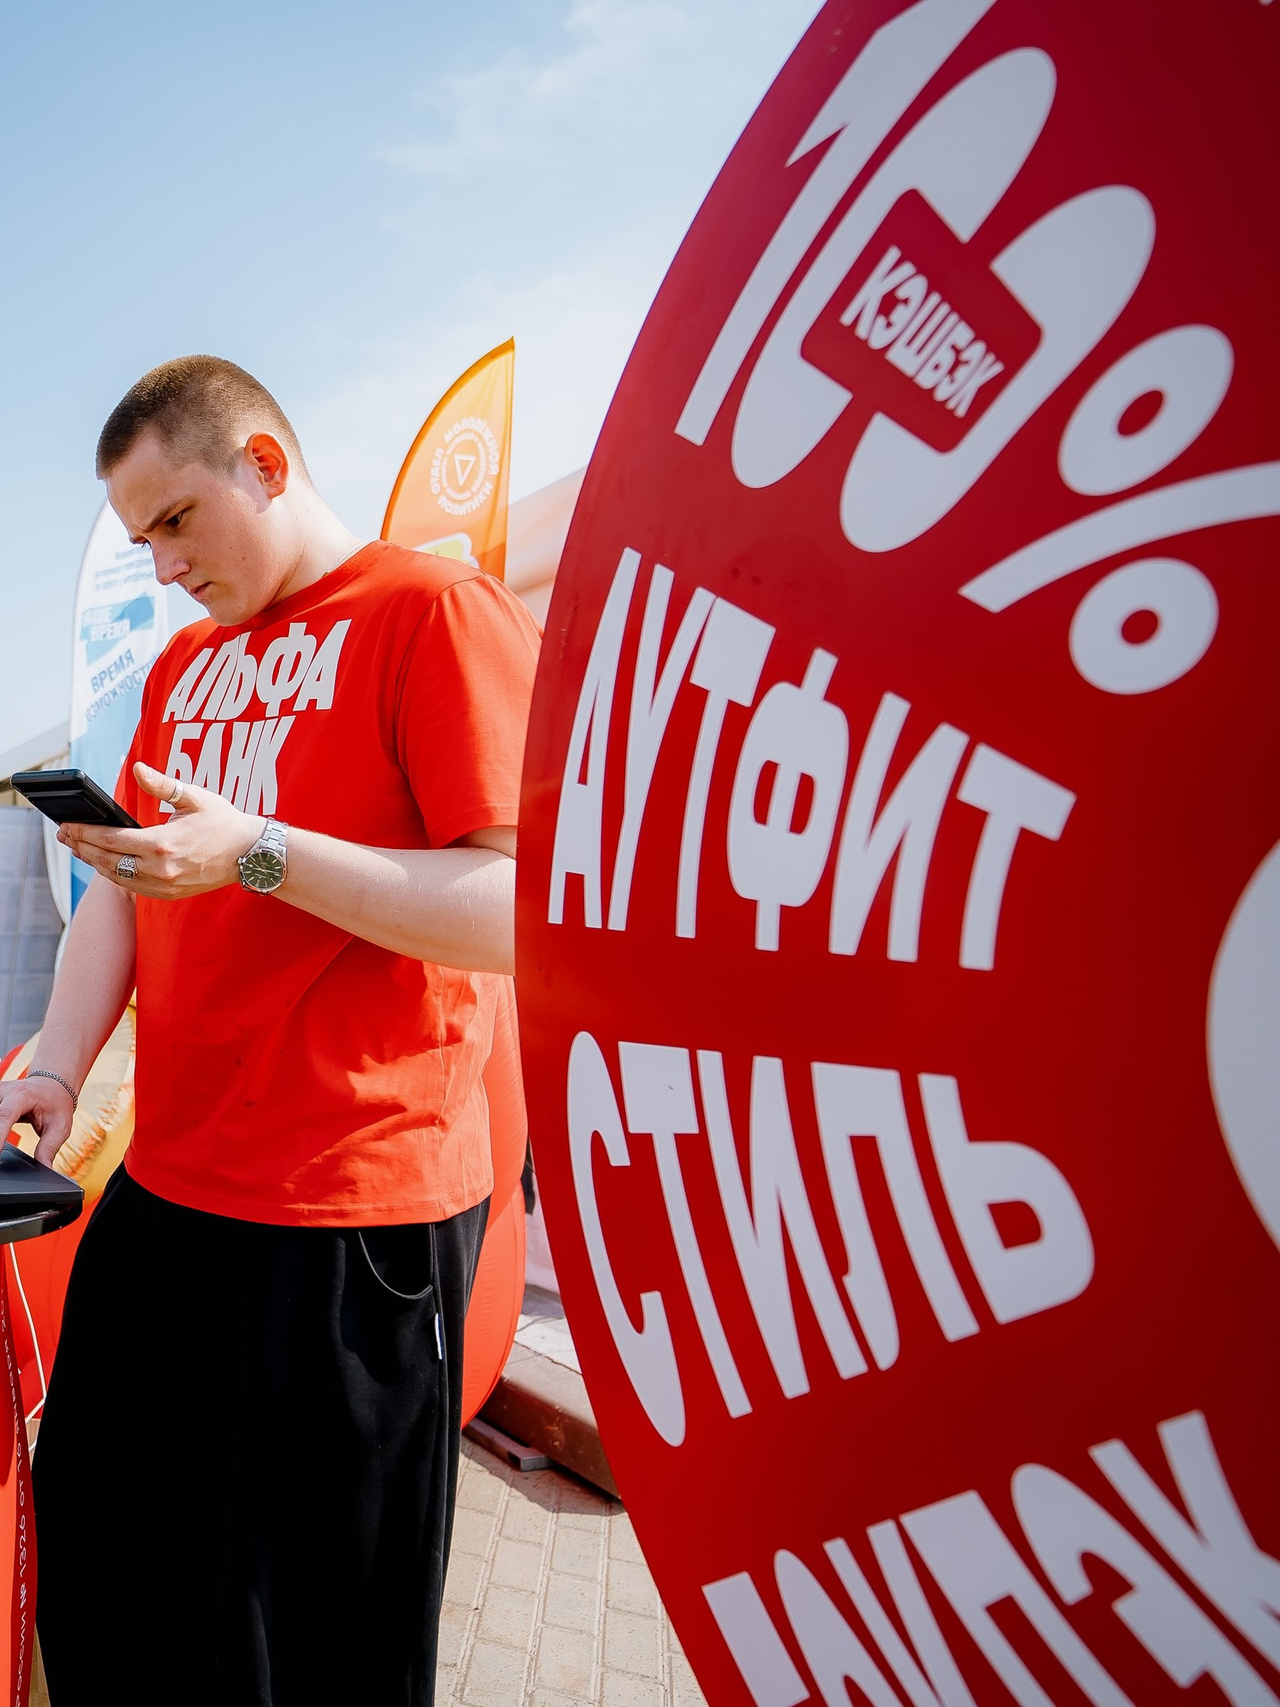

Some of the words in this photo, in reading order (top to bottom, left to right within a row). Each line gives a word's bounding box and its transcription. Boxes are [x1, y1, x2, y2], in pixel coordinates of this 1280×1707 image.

[839, 245, 1004, 418] КЭШБЭК
[91, 648, 135, 694] ВРЕМЯ
[161, 618, 352, 724] АЛЬФА
[158, 715, 297, 816] БАНК
[548, 546, 1077, 971] АУТФИТ
[566, 1031, 1096, 1447] СТИЛЬ
[16, 1442, 23, 1473] 16
[19, 1480, 26, 1507] от
[19, 1514, 27, 1578] 1326
